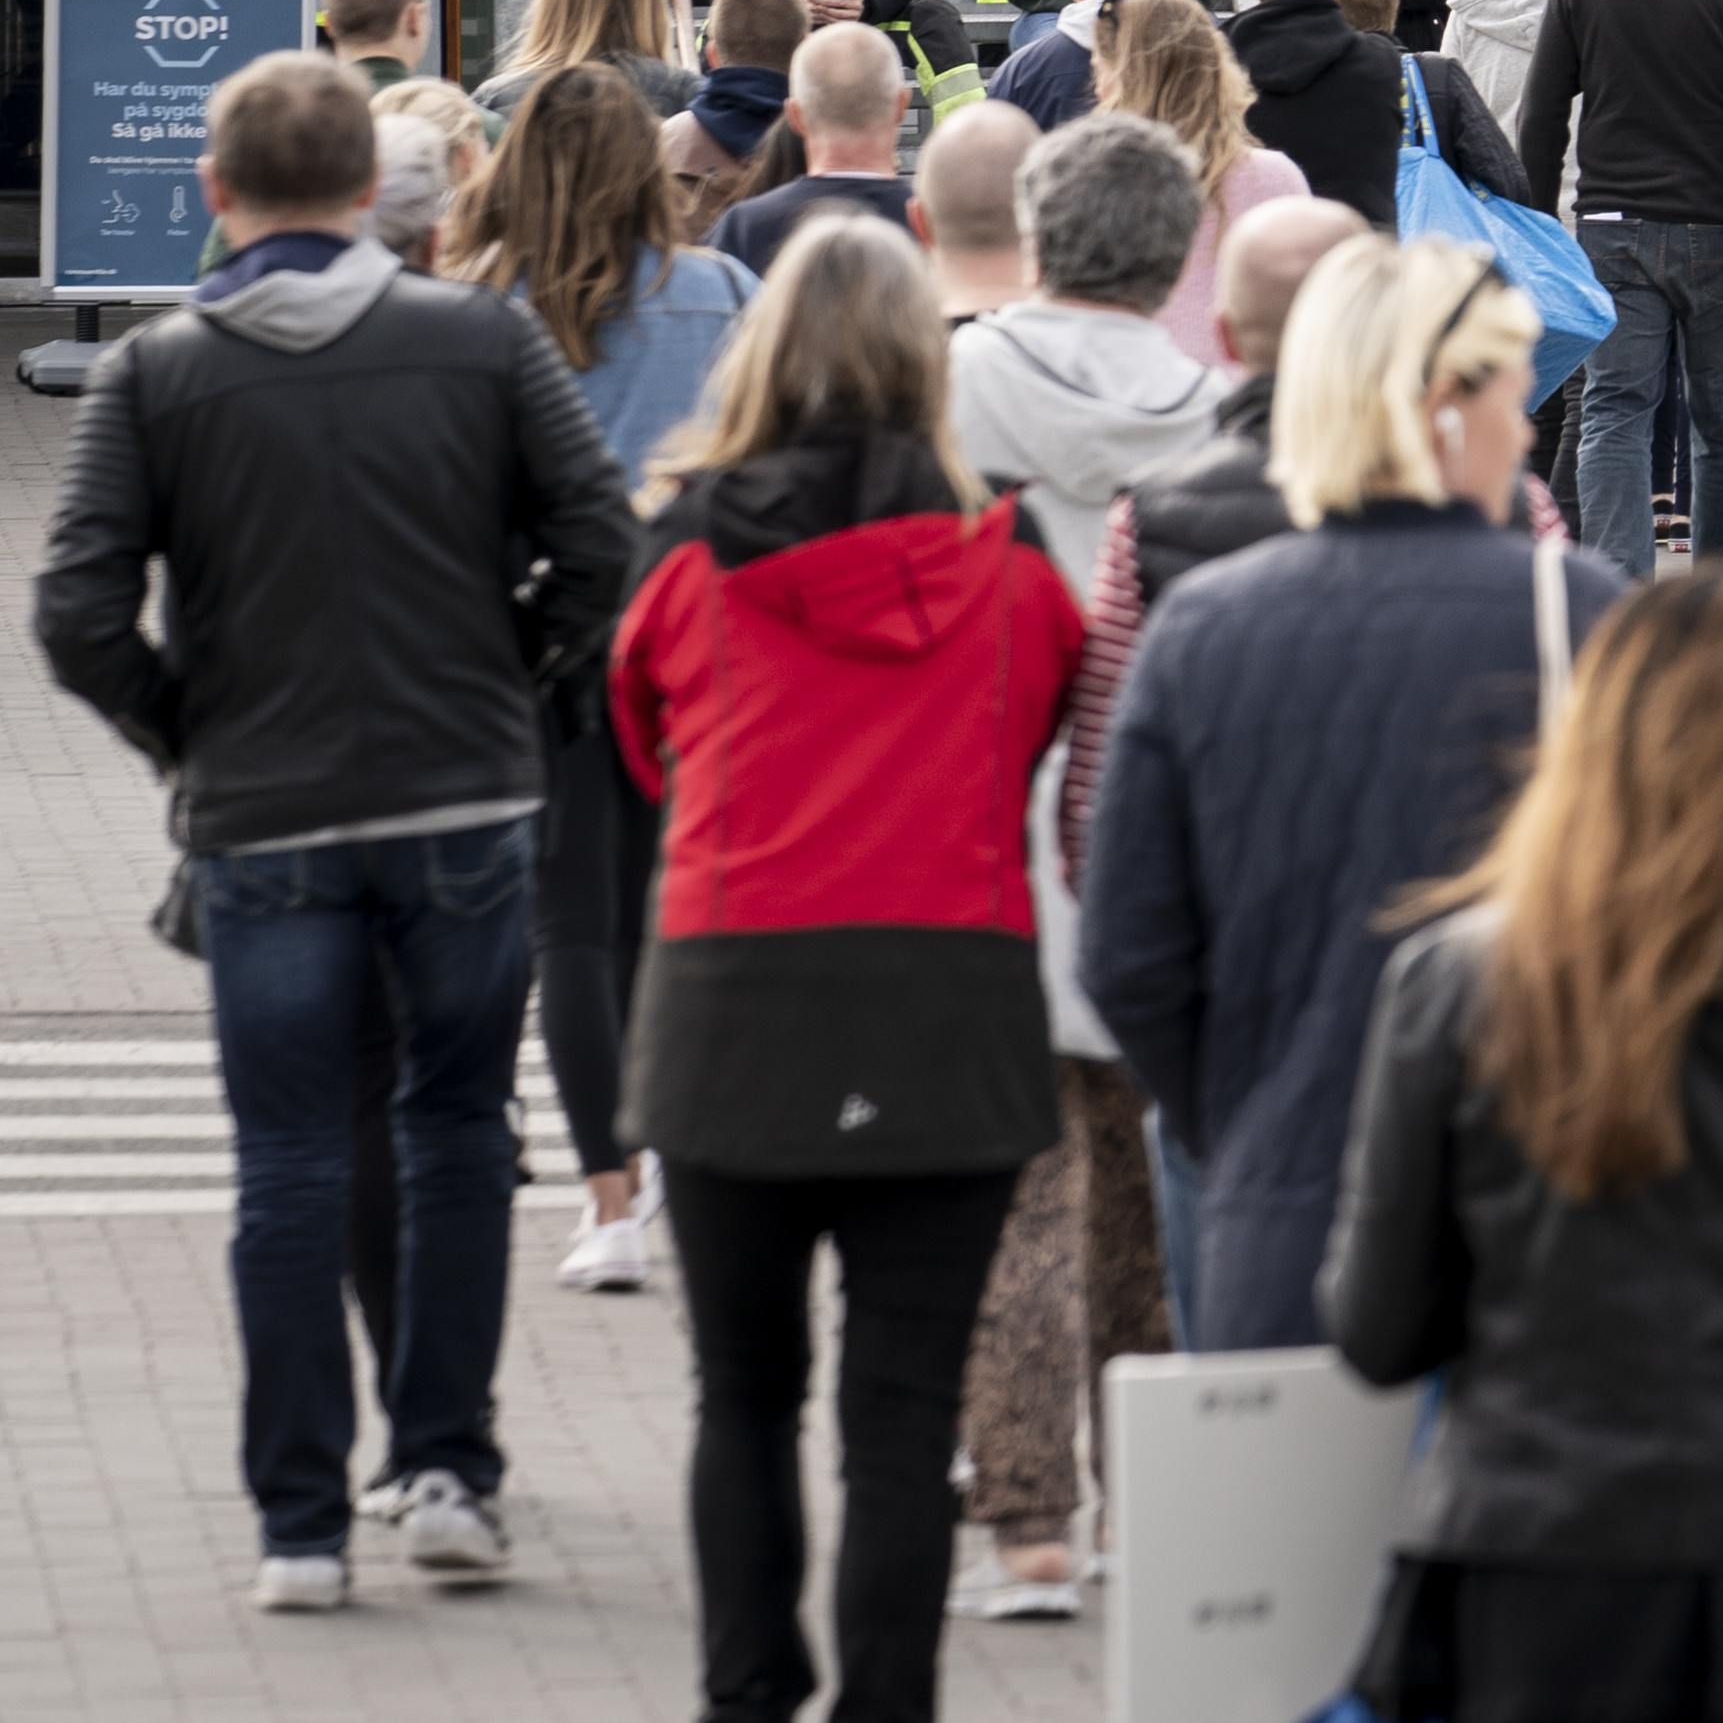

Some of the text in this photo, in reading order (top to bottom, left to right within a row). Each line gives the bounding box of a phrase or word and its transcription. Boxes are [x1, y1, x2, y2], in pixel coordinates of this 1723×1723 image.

[134, 16, 229, 40] STOP!
[93, 81, 214, 100] Har du symp
[123, 102, 210, 121] på sygdo
[111, 122, 208, 142] Så gå ikke
